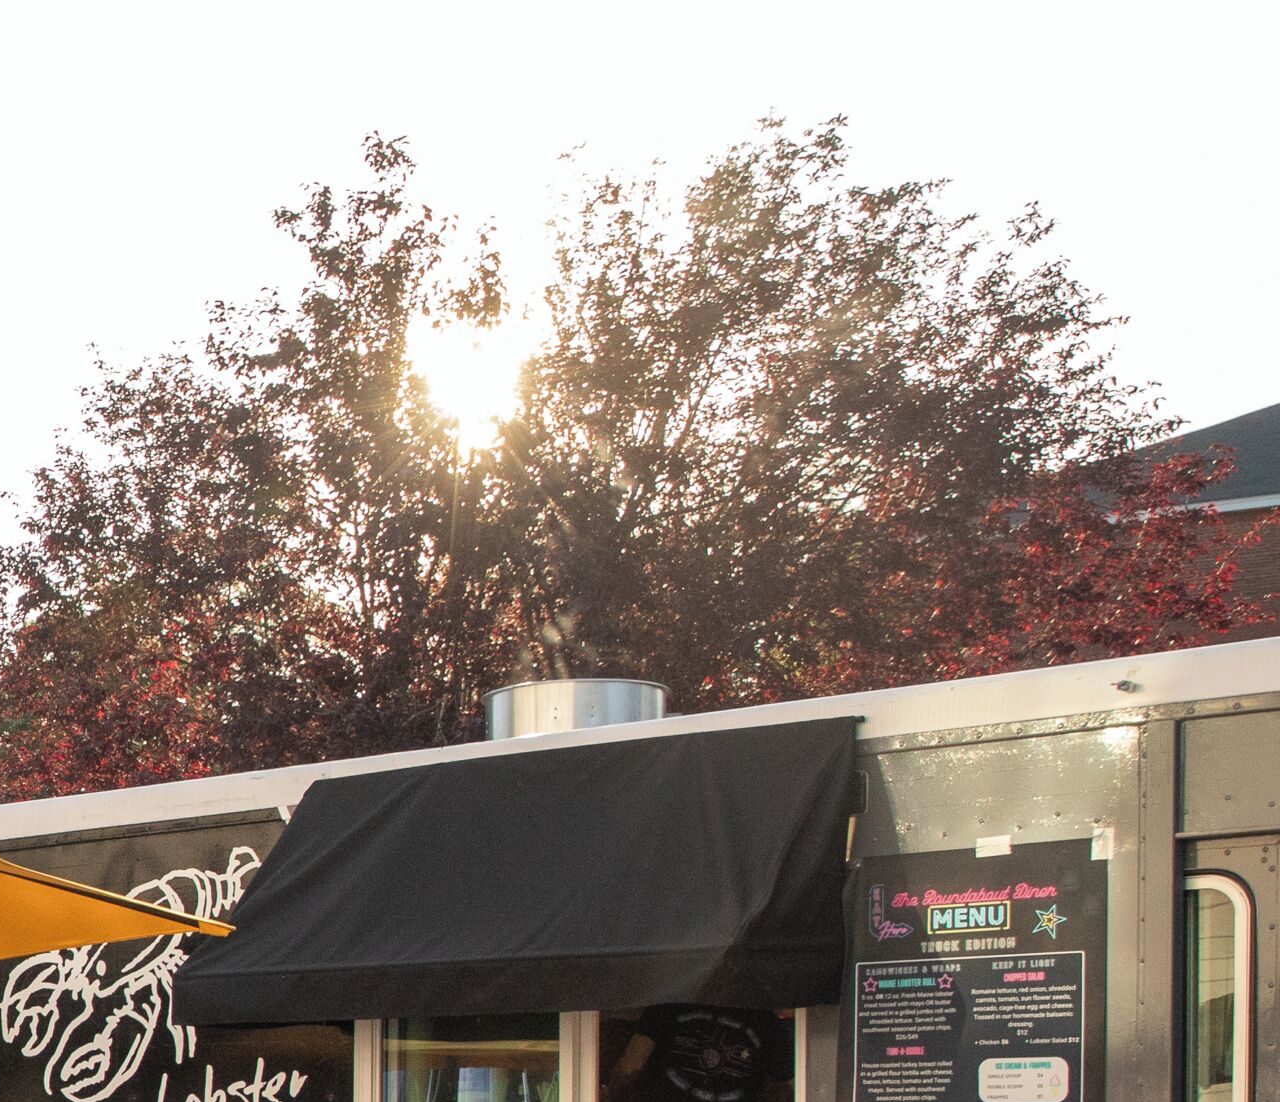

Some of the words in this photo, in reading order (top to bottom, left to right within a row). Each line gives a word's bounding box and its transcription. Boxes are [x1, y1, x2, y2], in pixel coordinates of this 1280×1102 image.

[892, 892, 918, 908] The
[922, 885, 1010, 906] Roundabout
[1013, 883, 1057, 899] Diner
[933, 906, 1005, 929] MENU
[920, 940, 959, 953] TRUCK
[965, 937, 1015, 951] EDITION
[866, 966, 918, 975] SANDWICHES
[932, 964, 960, 972] WRAPS
[992, 961, 1014, 969] KEEP
[1030, 959, 1055, 968] LIGHT
[1028, 972, 1045, 981] SALAD
[898, 978, 921, 987] LOBSTER
[923, 978, 936, 986] ROLL
